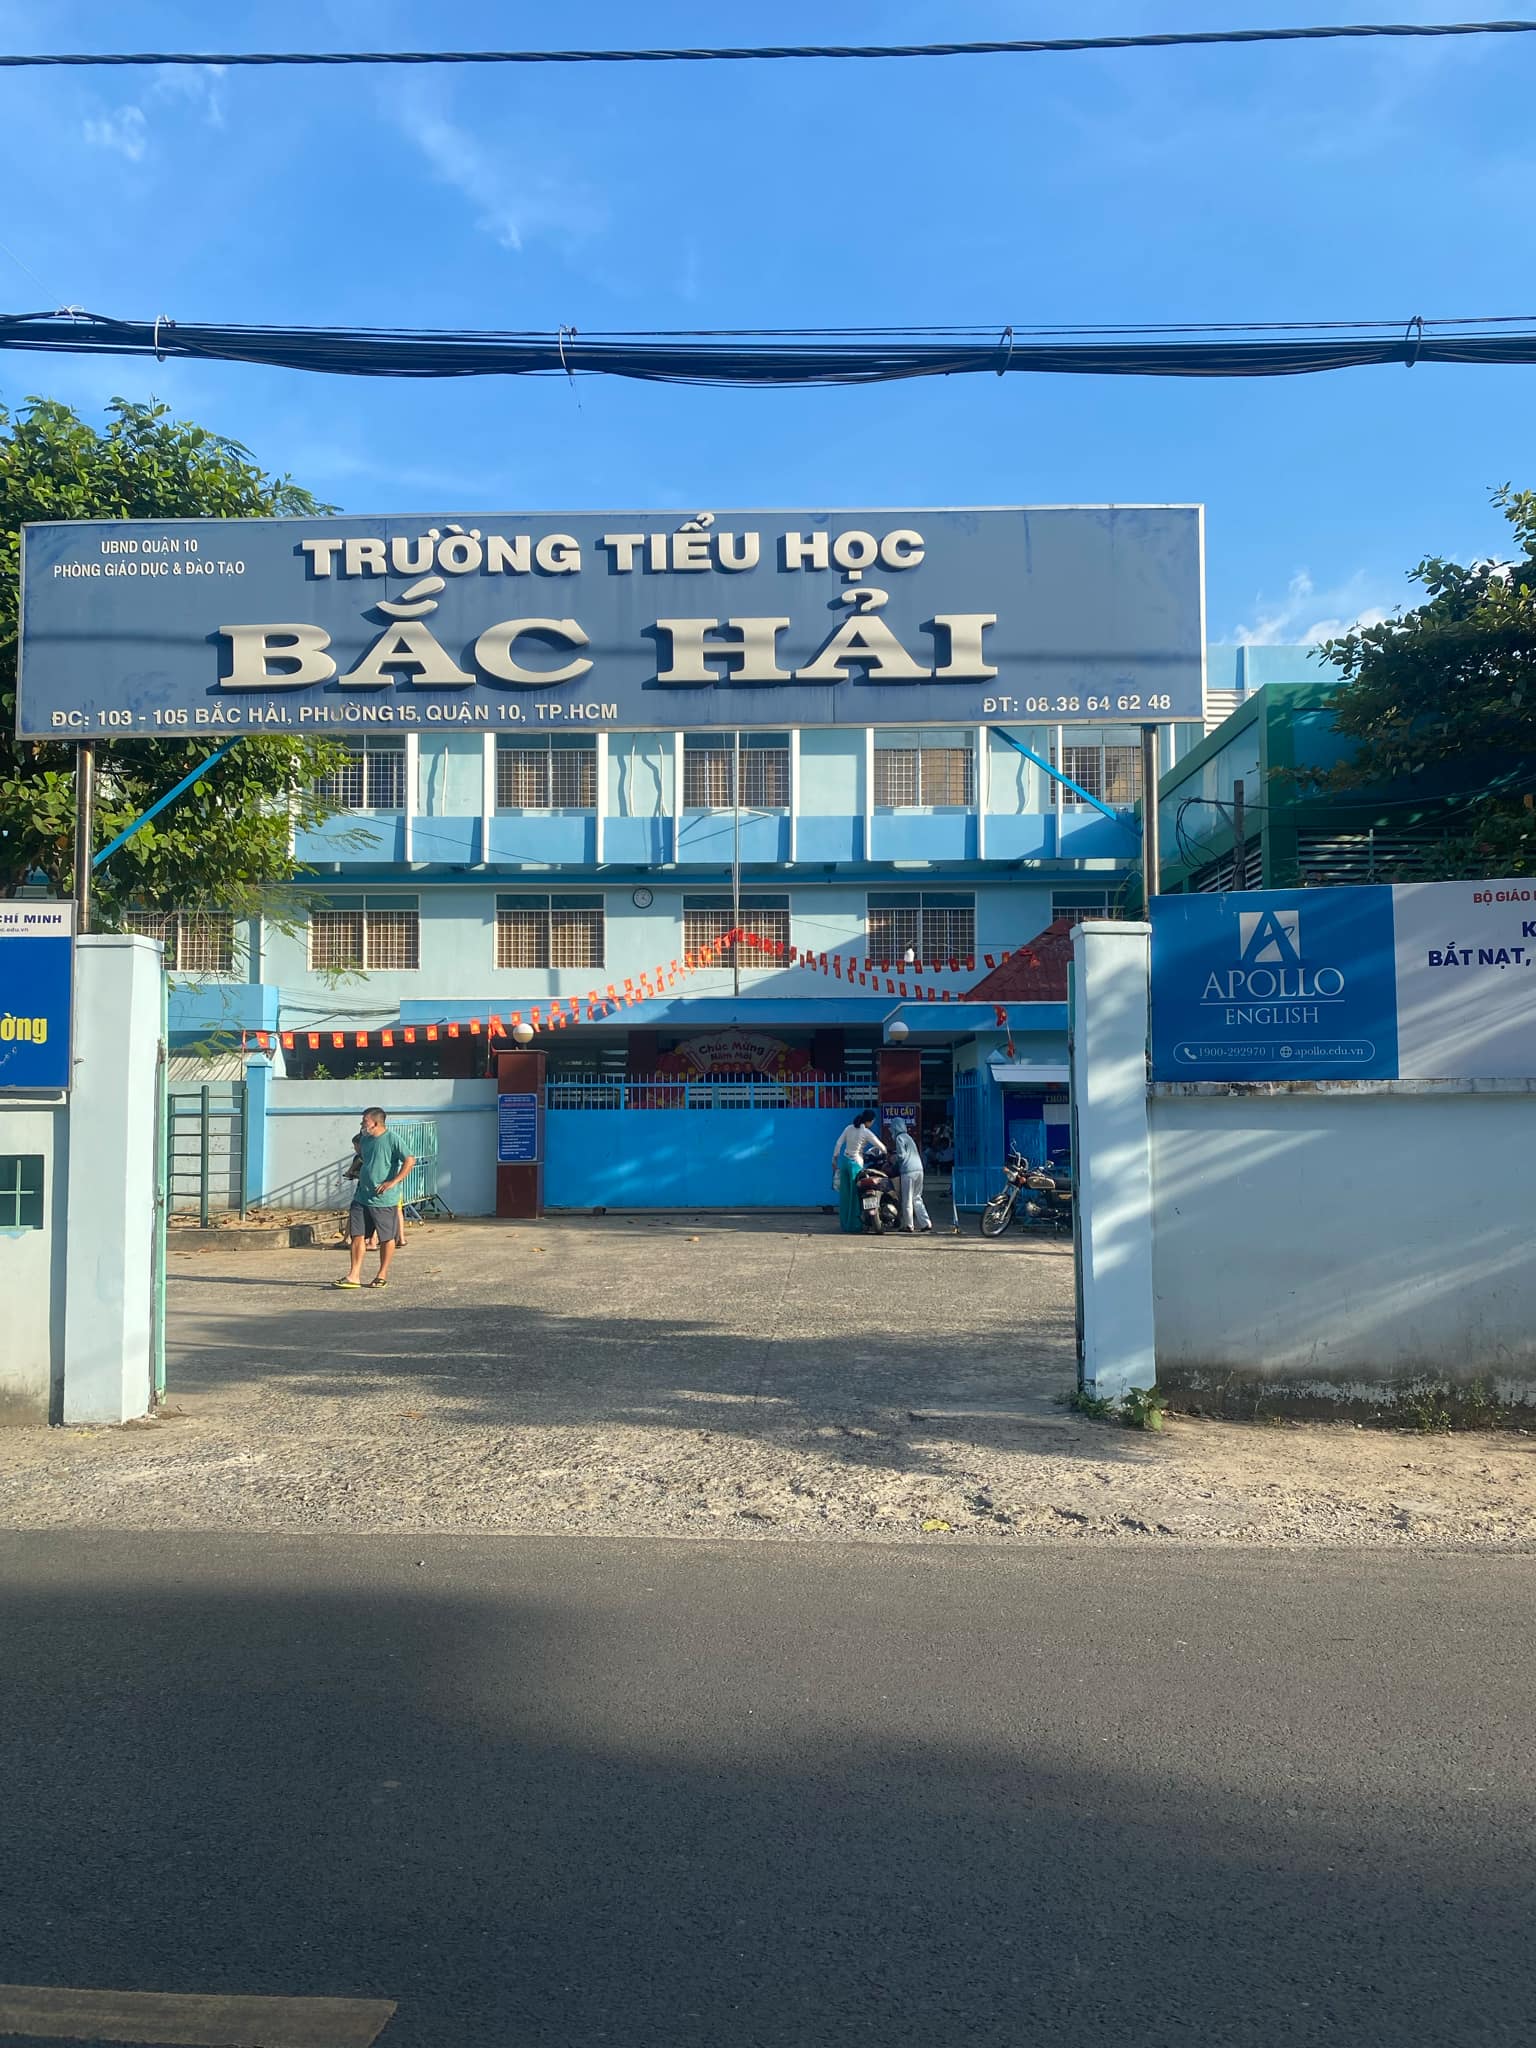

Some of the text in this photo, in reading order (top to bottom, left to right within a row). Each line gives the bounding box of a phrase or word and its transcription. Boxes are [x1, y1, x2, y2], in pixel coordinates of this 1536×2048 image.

[101, 536, 198, 556] UBND QUẬN 10
[302, 512, 925, 580] TRƯỜNG TIỂU HỌC
[53, 558, 245, 578] PHÒNG GIÁO DỤC & ĐÀO TẠO
[219, 576, 998, 688] BẮC HẢI
[983, 694, 1172, 713] ĐT: 08.38 64 62 48
[51, 710, 90, 727] ĐC:
[97, 709, 132, 726] 103
[153, 708, 188, 724] 105
[195, 701, 241, 724] BẮC
[248, 701, 293, 725] HẢI,
[396, 705, 421, 723] 15,
[425, 701, 490, 725] QUẬN
[498, 704, 527, 723] 10,
[535, 703, 618, 721] TP.HCM
[1473, 889, 1493, 906] BỘ
[1495, 888, 1531, 902] GIÁO
[0, 912, 62, 924] HÍ MINH
[1428, 941, 1532, 969] BẮT NẠT,
[1201, 967, 1345, 1000] APOLLO
[1226, 1006, 1319, 1025] ENGLISH
[0, 1012, 48, 1044] ờng
[1294, 1045, 1364, 1058] apollo.edu.vn
